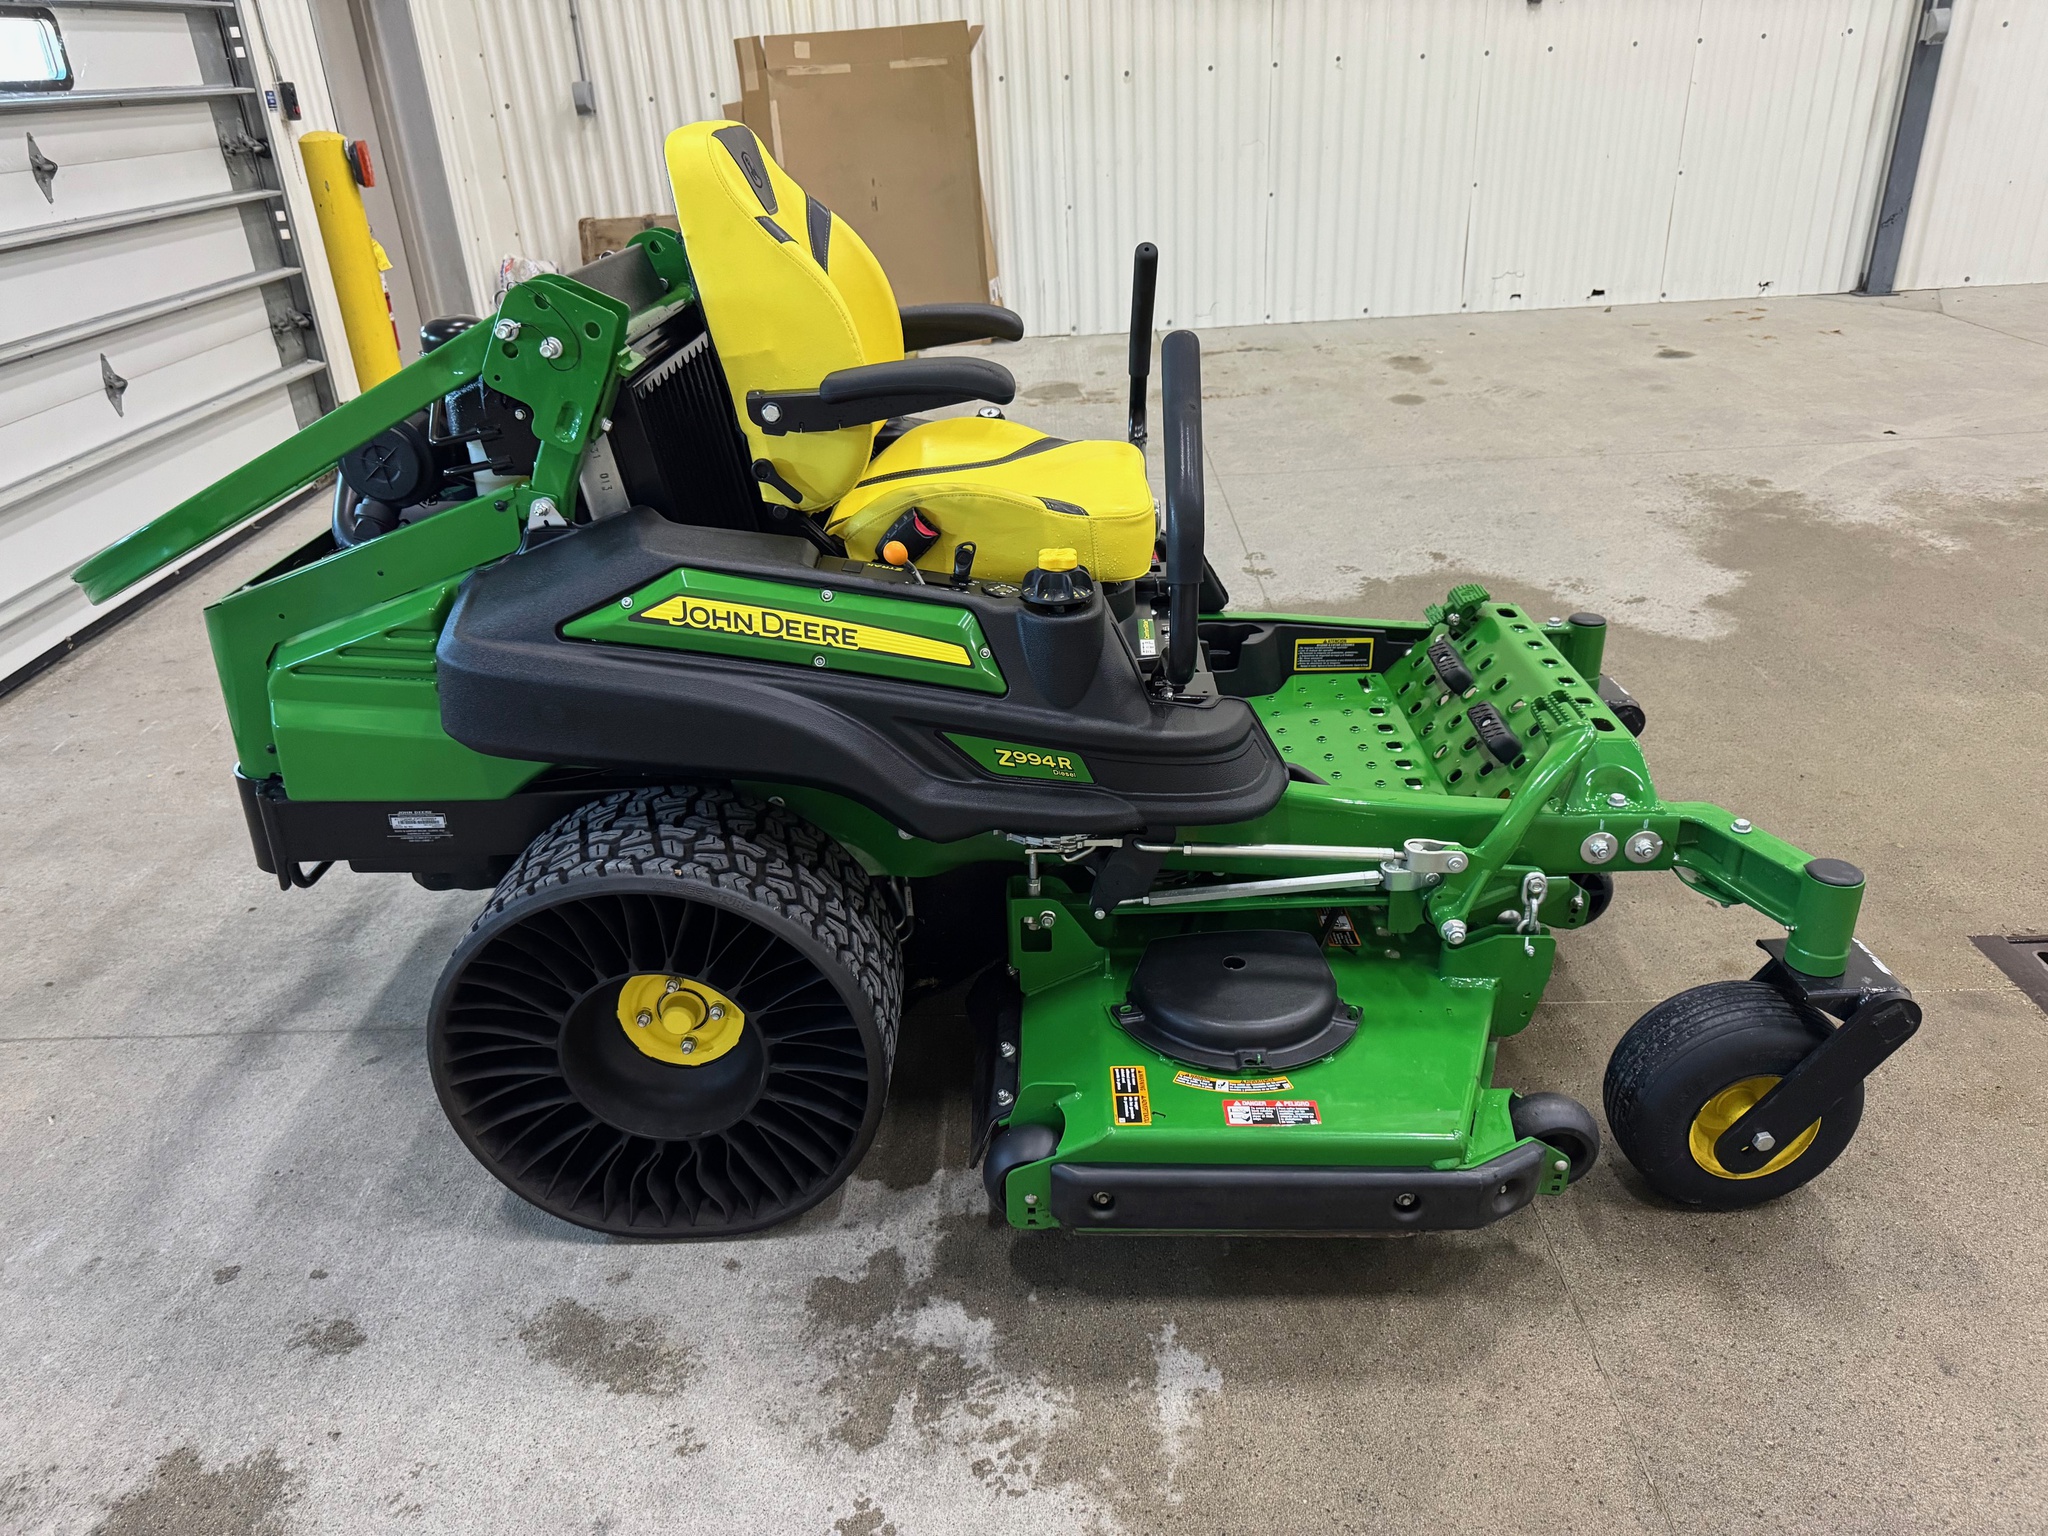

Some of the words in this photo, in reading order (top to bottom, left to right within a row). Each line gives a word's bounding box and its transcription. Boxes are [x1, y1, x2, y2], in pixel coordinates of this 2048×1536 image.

[672, 601, 753, 631] JOHN
[761, 611, 858, 647] DEERE
[1052, 769, 1077, 778] Diesel
